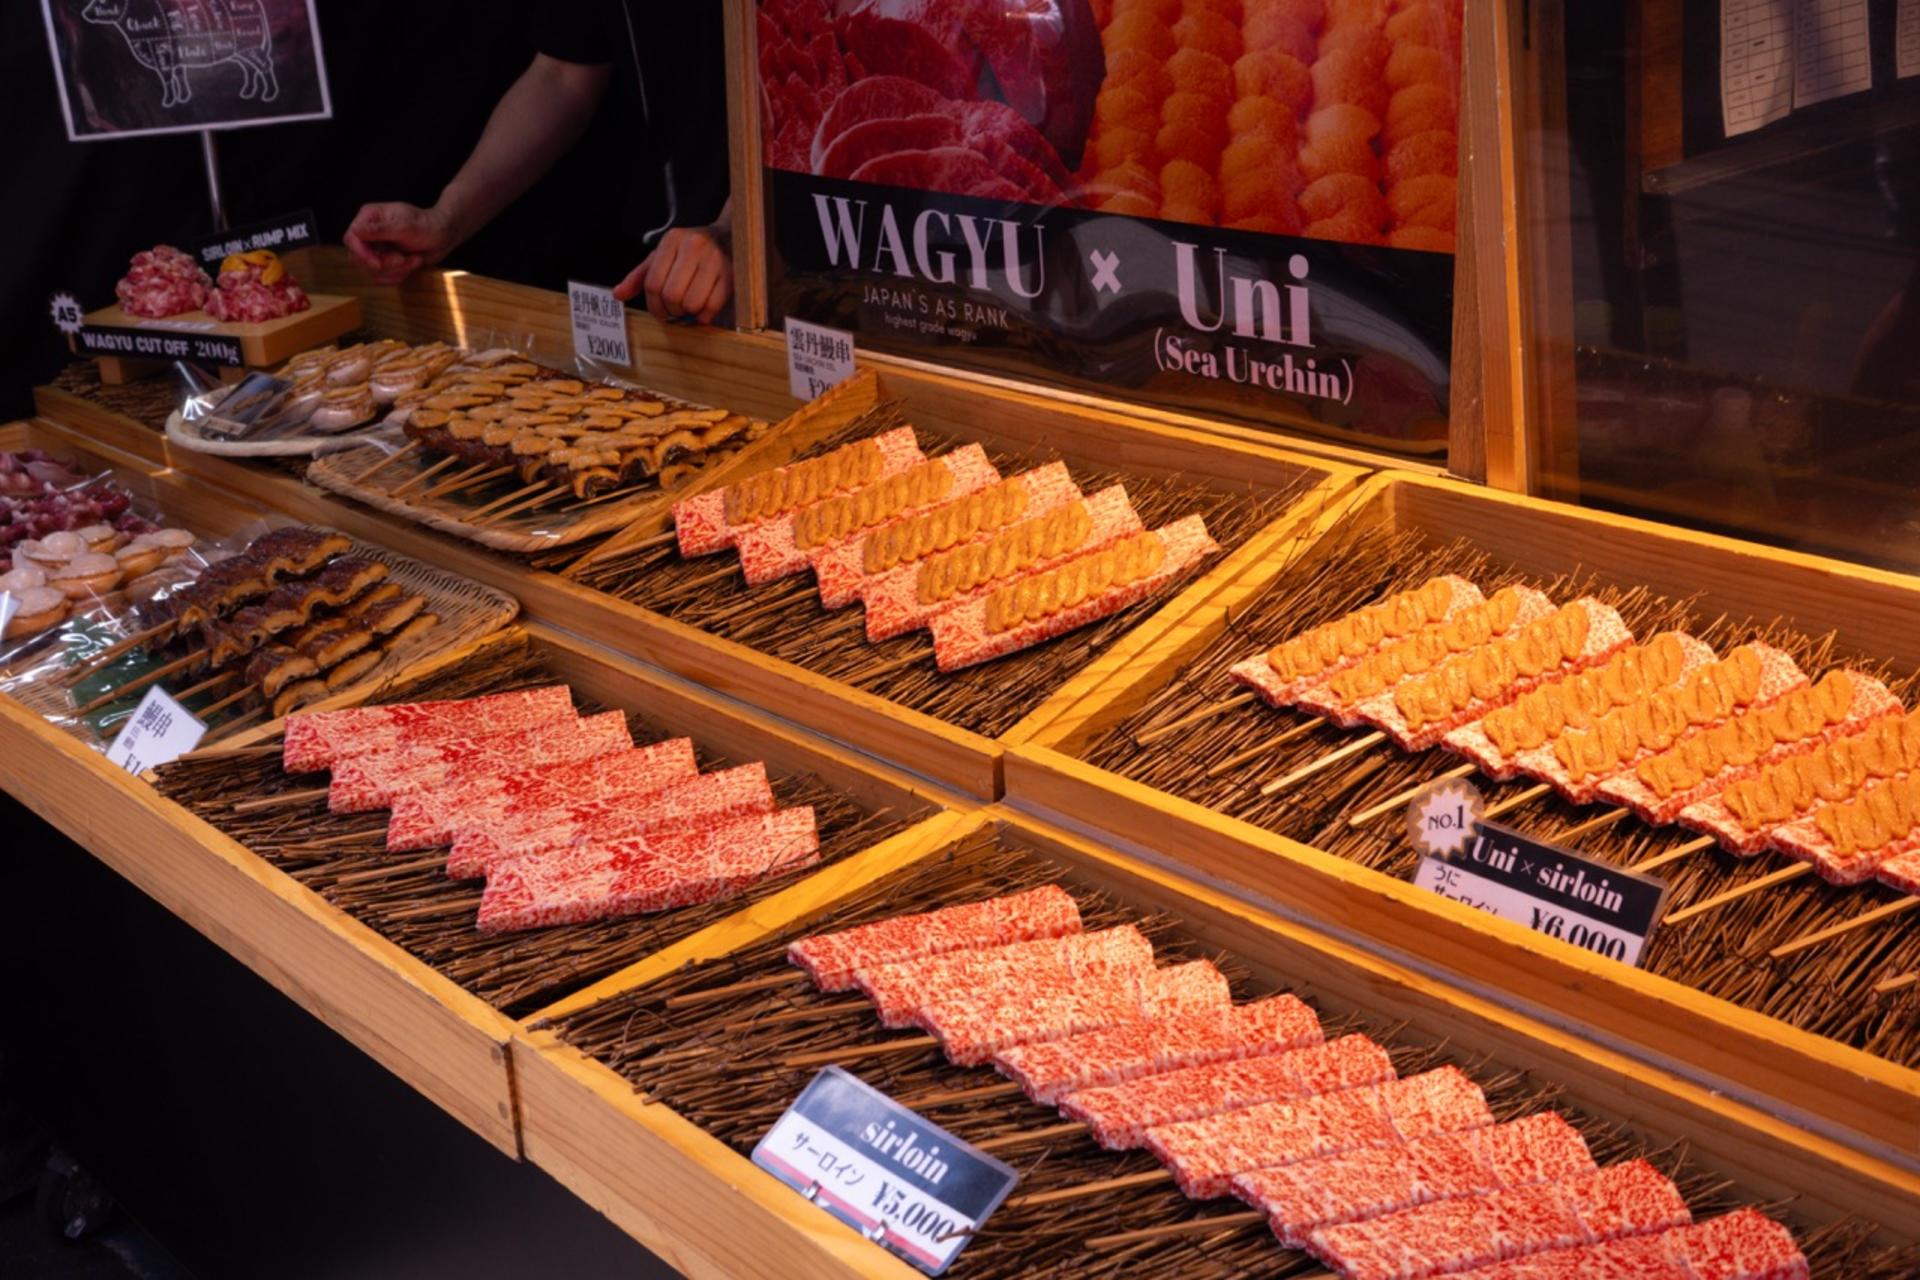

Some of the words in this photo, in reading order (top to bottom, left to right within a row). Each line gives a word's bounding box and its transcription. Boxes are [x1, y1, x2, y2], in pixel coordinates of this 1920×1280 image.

[251, 230, 284, 249] RUMP
[288, 223, 308, 241] MIX
[811, 193, 1046, 299] WAGYU
[1171, 241, 1316, 348] Uni
[57, 306, 77, 323] A5
[936, 298, 957, 319] A5
[964, 303, 1009, 329] RANK
[82, 331, 132, 351] WAGYU
[136, 336, 162, 354] CUT
[164, 339, 189, 357] OFF
[196, 342, 240, 364] 200g
[1154, 327, 1221, 381] (Sea
[1226, 346, 1354, 405] Urchin)
[1433, 865, 1461, 887] うに
[1472, 835, 1519, 874] Uni
[1536, 863, 1624, 912] sirloin
[792, 1132, 865, 1186] サーロイン
[859, 1120, 949, 1184] sirloin
